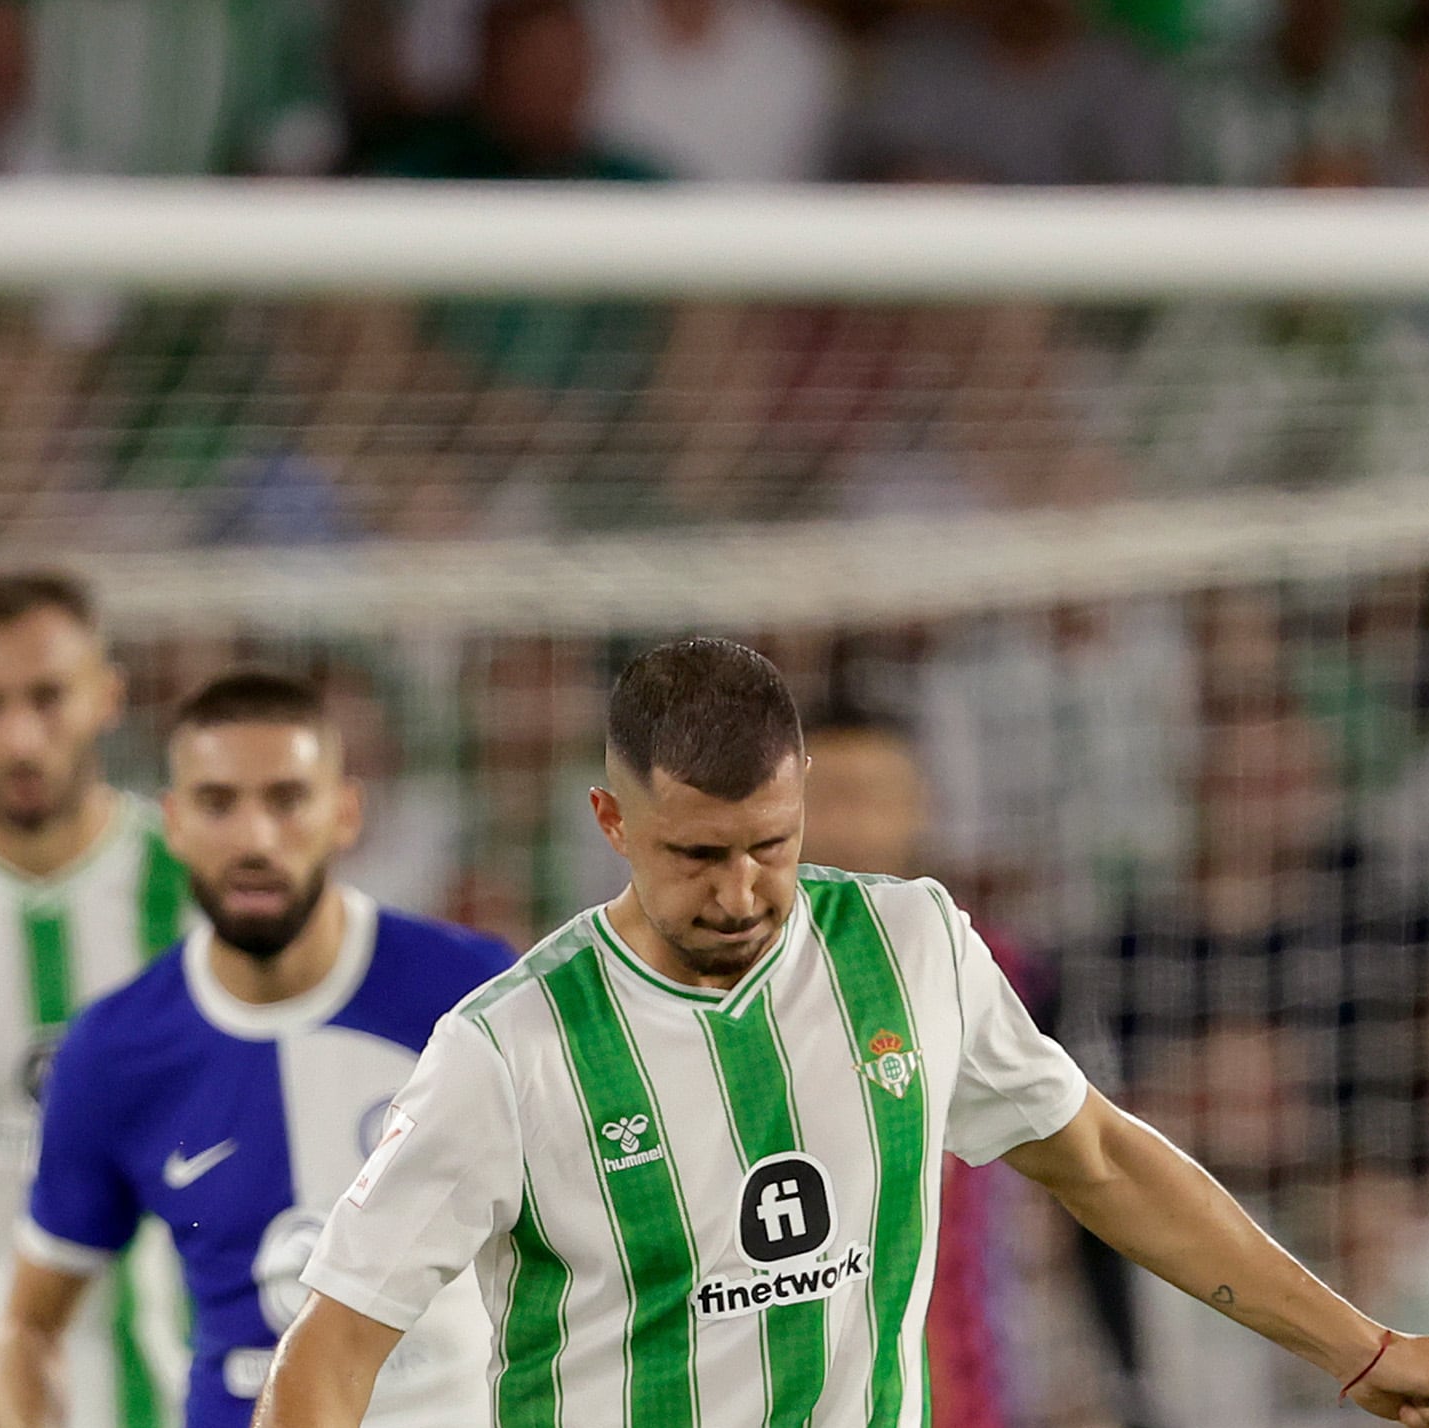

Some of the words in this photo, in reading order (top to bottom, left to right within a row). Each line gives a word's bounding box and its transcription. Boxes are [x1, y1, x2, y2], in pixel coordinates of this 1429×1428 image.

[603, 1144, 664, 1173] hummel
[756, 1179, 807, 1242] fi
[697, 1248, 865, 1314] finetwork
